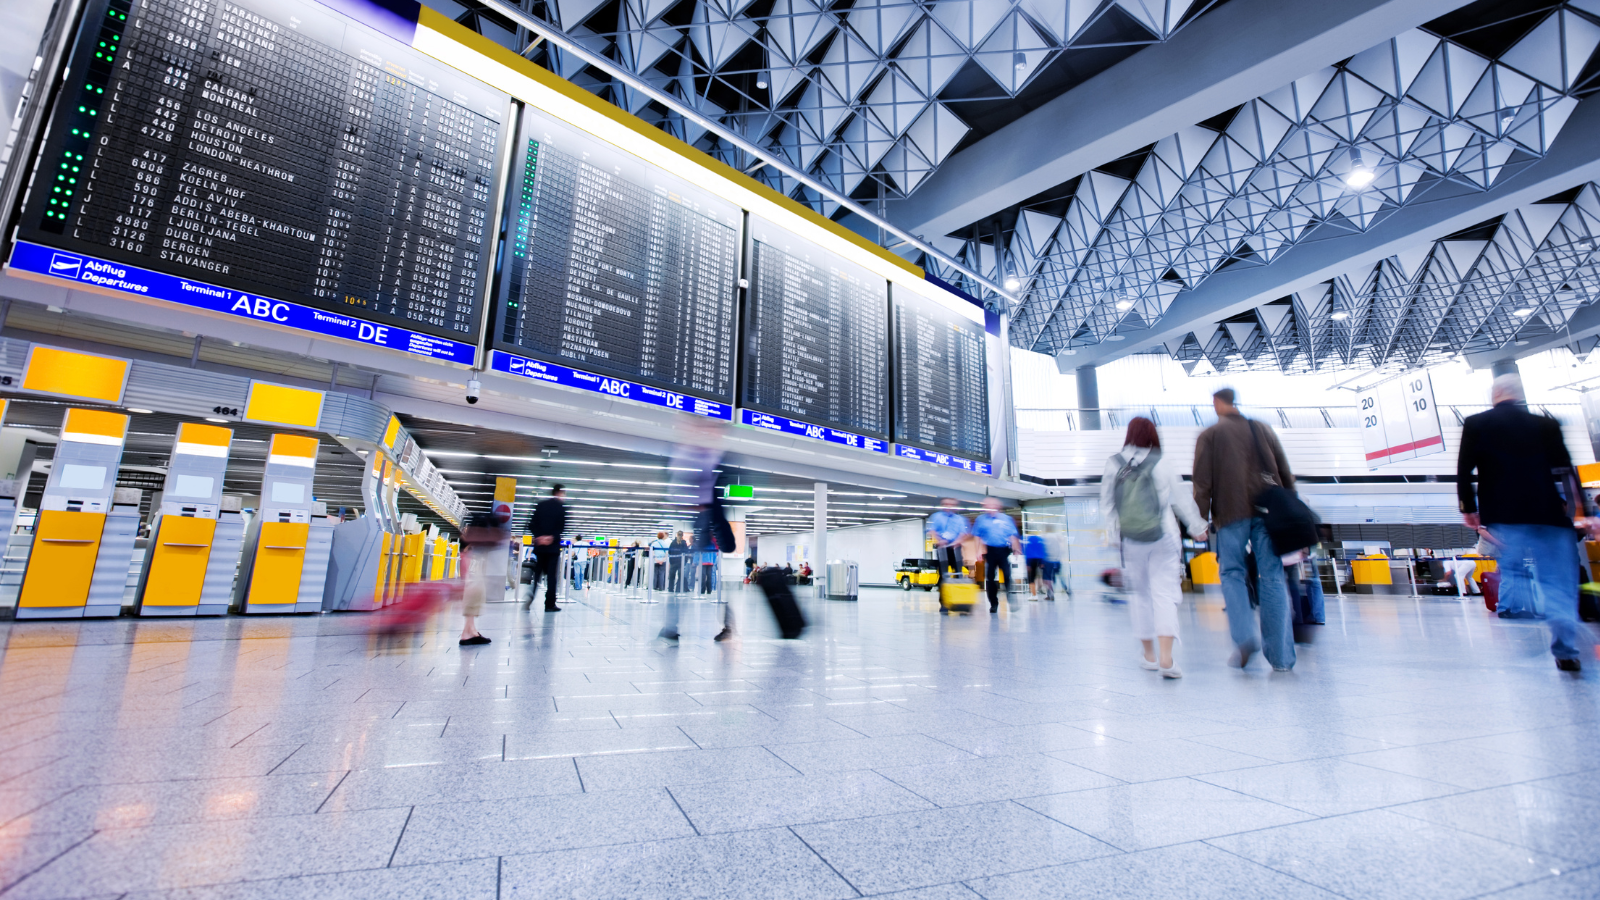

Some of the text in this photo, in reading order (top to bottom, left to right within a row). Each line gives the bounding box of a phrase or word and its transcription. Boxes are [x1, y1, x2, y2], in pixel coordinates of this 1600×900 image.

[225, 3, 278, 32] VARADERO
[181, 16, 250, 51] 462 MIAMI
[184, 7, 274, 51] 468 PORTLAND
[222, 13, 275, 41] HELSINKI
[167, 33, 197, 50] 3236
[167, 66, 189, 80] 494
[205, 80, 254, 105] CALGARY
[164, 76, 186, 90] 875
[202, 90, 258, 117] MONTREAL
[156, 107, 178, 121] 442
[194, 121, 244, 144] DETROIT
[159, 97, 181, 111] 456
[197, 110, 218, 124] LOS
[226, 121, 274, 144] ANGELES
[153, 118, 176, 132] 440
[191, 131, 242, 154] HOUSTON
[141, 125, 173, 142] 4726
[189, 141, 294, 182] LONDON-HEATHROW
[144, 150, 167, 164] 417
[183, 162, 228, 183] ZAGREB
[132, 158, 164, 174] 6808
[180, 173, 218, 191] KOELN
[226, 187, 247, 200] HBF
[138, 172, 161, 185] 686
[178, 184, 200, 197] TEL
[208, 193, 237, 208] AVIV
[133, 194, 155, 207] 176
[172, 206, 260, 237] BERLIN-TEGEL
[135, 183, 158, 196] 590
[175, 195, 213, 212] ADDIS
[220, 208, 316, 242] ABEBA-KHARTOUM
[116, 214, 149, 230] 4980
[166, 228, 212, 247] DUBLIN
[129, 206, 152, 219] 117
[169, 217, 237, 242] LJUBLJANA
[113, 226, 146, 241] 3126
[163, 239, 210, 258] BERGEN
[573, 237, 603, 253] NEW YORK
[110, 237, 143, 253] 3160
[160, 250, 229, 274] STAVANGER
[572, 245, 599, 259] KOLKATA
[85, 260, 126, 278] Abflug
[571, 261, 597, 274] CHICAGO
[572, 253, 633, 279] DALLAS FORT WORTH
[82, 271, 148, 293] Departures
[570, 269, 596, 282] DETROIT
[180, 281, 224, 299] Terminal
[569, 276, 588, 287] PARIS
[592, 284, 602, 292] CH.
[618, 293, 638, 304] GAULLE
[231, 295, 290, 322] ABC
[565, 309, 592, 321] VILNIUS
[313, 312, 357, 328] Terminal 2
[564, 317, 592, 329] TORONTO
[358, 322, 389, 344] DE
[564, 325, 594, 338] HELSINKI
[409, 343, 433, 351] Departures
[561, 350, 584, 361] DUBLIN
[526, 360, 546, 372] Abflug
[0, 376, 12, 385] 5
[525, 369, 558, 381] Departures
[573, 371, 596, 382] Terminal
[599, 379, 630, 397] ABC
[642, 387, 661, 397] Terminal
[1409, 379, 1422, 393] 10
[666, 394, 683, 409] DE
[1362, 397, 1374, 410] 20
[1413, 398, 1426, 412] 10
[213, 406, 238, 416] 464
[761, 414, 774, 423] Abflug
[761, 421, 781, 430] Departures
[789, 421, 804, 429] Terminal
[1365, 415, 1377, 428] 20
[806, 428, 824, 439] ABC
[831, 430, 844, 438] Terminal
[847, 434, 858, 446] DE
[936, 455, 949, 465] ABC
[963, 461, 971, 469] DE
